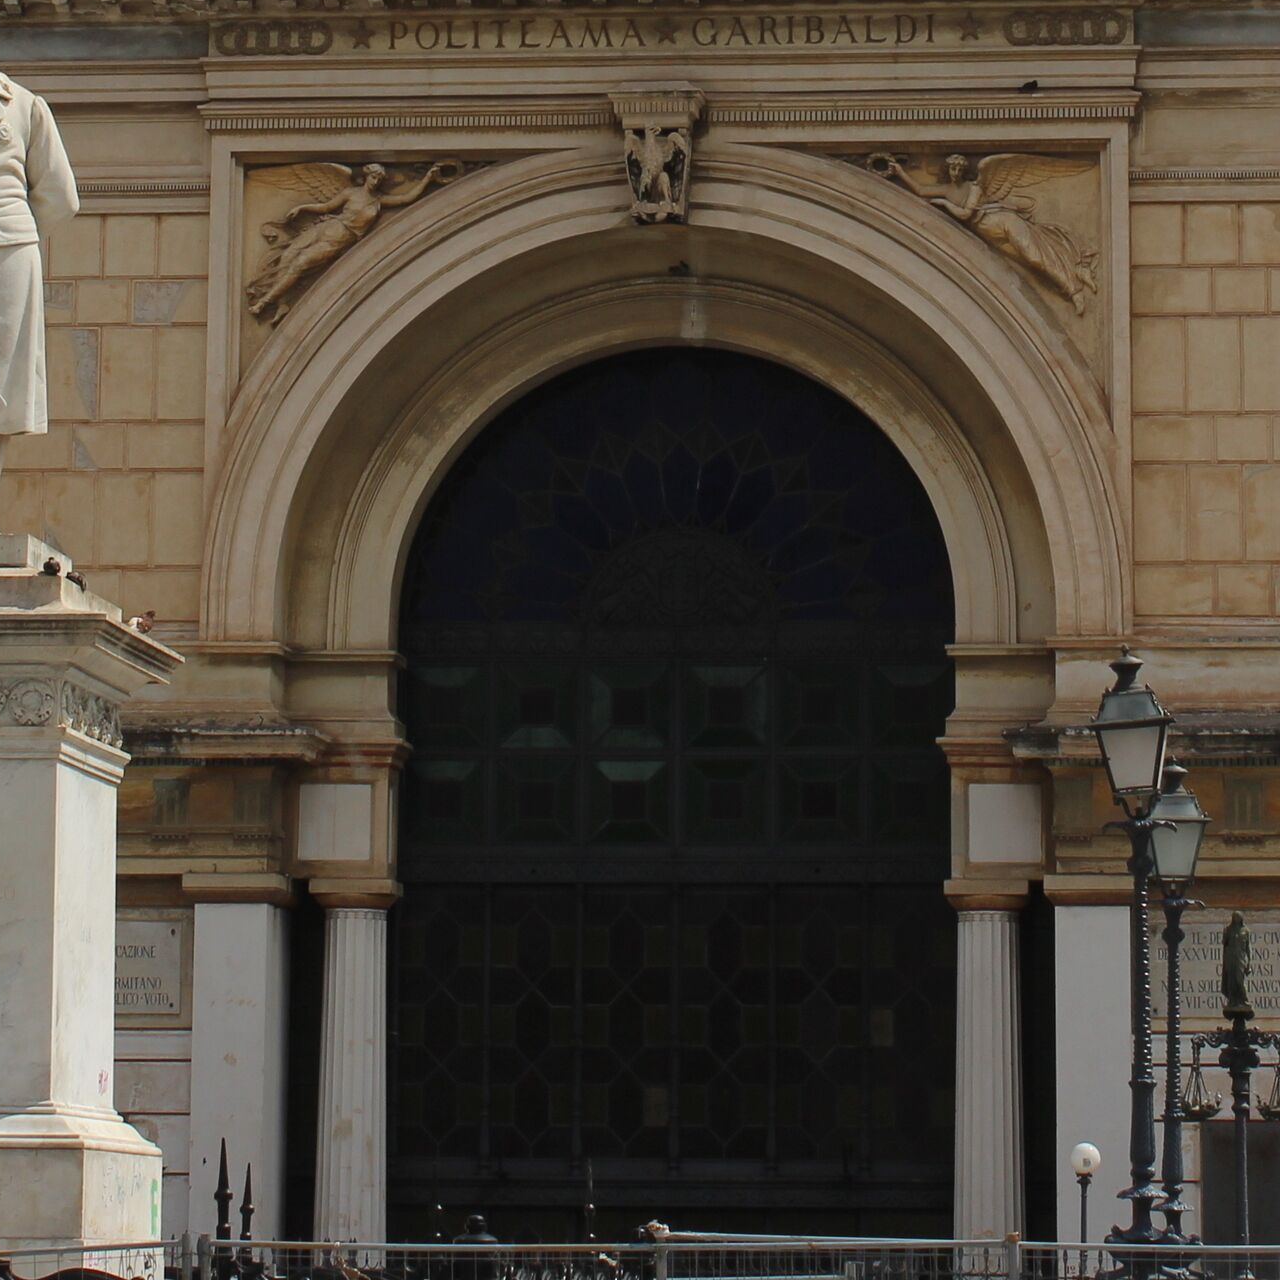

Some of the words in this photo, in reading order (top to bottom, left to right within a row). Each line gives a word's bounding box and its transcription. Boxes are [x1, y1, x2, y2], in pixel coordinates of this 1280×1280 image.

[387, 18, 647, 50] POLITEAMA
[691, 14, 937, 47] GARIBALDI
[115, 944, 157, 959] CAZIONE
[114, 976, 162, 991] RMITANO
